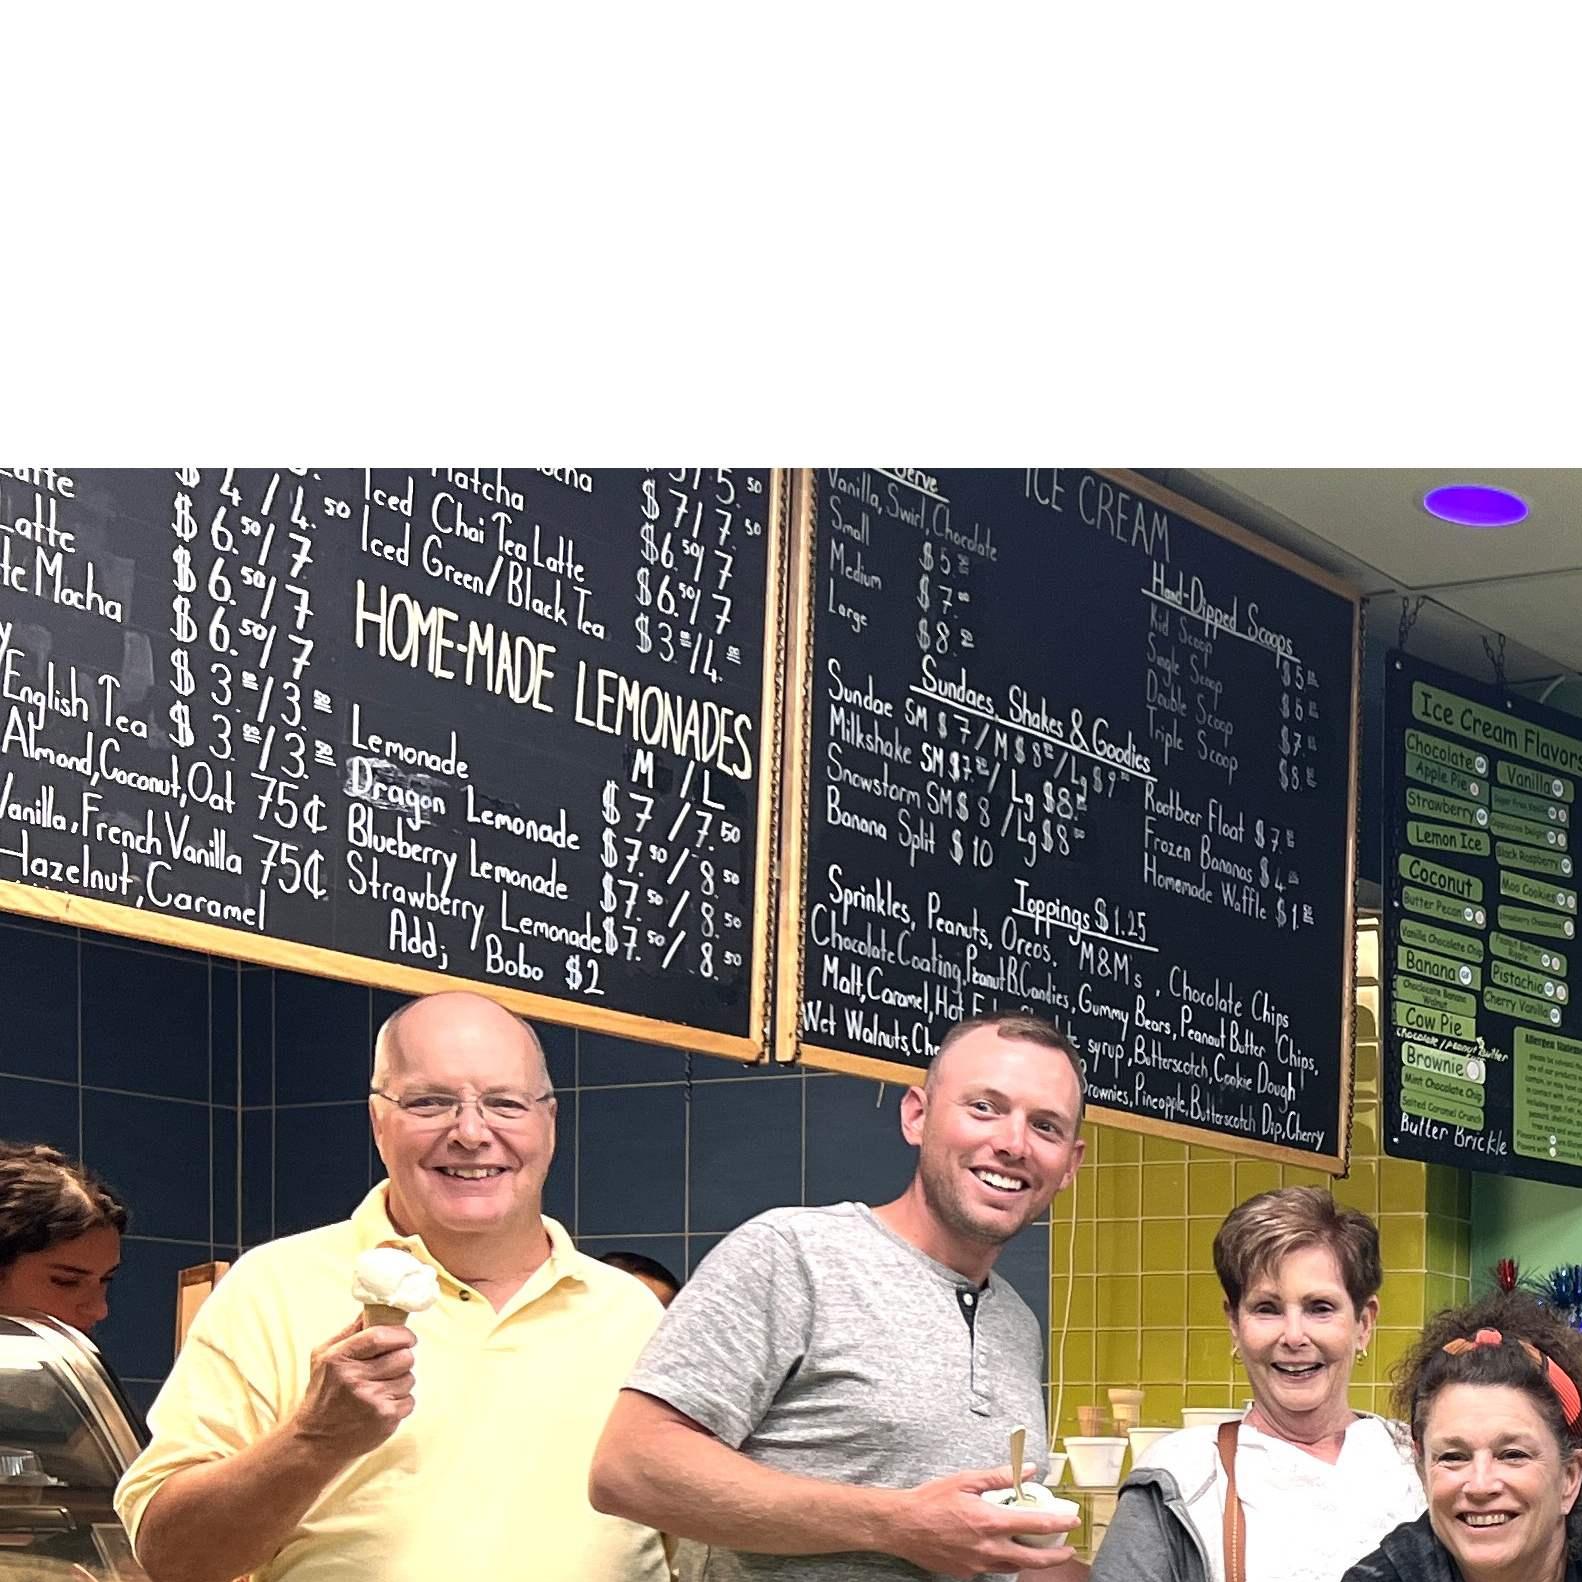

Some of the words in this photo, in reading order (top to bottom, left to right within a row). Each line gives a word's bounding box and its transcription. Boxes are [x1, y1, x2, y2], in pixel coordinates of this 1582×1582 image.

[0, 493, 76, 553] atte
[431, 491, 485, 544] Chai
[490, 511, 528, 562] Tea
[533, 523, 585, 583] Latte
[829, 494, 870, 547] Small
[932, 502, 998, 562] Chocolate
[1078, 475, 1170, 564] CREAM
[361, 503, 411, 567] Iced
[572, 585, 605, 641] Tea
[829, 538, 882, 591] Medium
[827, 577, 868, 633] Large
[1150, 600, 1170, 637] Kid
[1178, 615, 1213, 669] Scoop
[1151, 559, 1238, 640] Hand-Dipped
[1247, 601, 1294, 669] Scoops
[2, 647, 90, 731] English
[97, 674, 149, 739] Tea
[354, 579, 557, 713] HOME-MADE
[573, 659, 753, 781] LEMONADES
[827, 657, 894, 718] Sundae
[903, 697, 929, 733] SM
[1146, 668, 1188, 717] Double
[1195, 693, 1234, 749] Scoop
[1189, 653, 1224, 712] Scoop
[351, 702, 470, 780] Lemonade
[829, 702, 913, 765] Milkshake
[919, 742, 944, 778] SM
[1008, 684, 1065, 739] Shakes
[1068, 707, 1090, 752] &
[1091, 717, 1152, 774] Goodies
[1145, 704, 1185, 767] Triple
[1197, 728, 1239, 785] Scoop
[1405, 732, 1475, 771] Chocolate
[1420, 691, 1455, 726] Ice
[1459, 707, 1518, 750] Cream
[187, 761, 236, 814] Oat
[350, 755, 447, 832] Dragon
[465, 785, 581, 851] Lemonade
[631, 748, 654, 789] M
[702, 769, 726, 811] L
[827, 741, 921, 810] Snowstorm
[926, 780, 954, 819] SM
[1407, 791, 1475, 824] Strawberry
[1415, 760, 1449, 784] Apple
[1450, 771, 1468, 791] Pie
[1507, 764, 1551, 795] Vanilla
[82, 791, 163, 856] French
[164, 810, 243, 875] Vanilla
[826, 784, 888, 841] Banana
[897, 807, 936, 868] Split
[1144, 780, 1203, 828] Rootbeer
[1207, 797, 1245, 844] Float
[1415, 825, 1457, 849] Lemon
[1459, 832, 1483, 852] Ice
[347, 802, 458, 900] Blueberry
[469, 838, 569, 901] Lemonade
[1143, 815, 1191, 863] Frozen
[1200, 833, 1254, 885] Bananas
[1408, 859, 1473, 898] Coconut
[146, 860, 266, 931] Caramel
[346, 850, 485, 951] Strawberry
[501, 890, 604, 954] Lemonade
[1013, 877, 1091, 946] Toppings
[1143, 851, 1214, 904] Homemade
[1221, 880, 1268, 920] Waffle
[1403, 890, 1434, 910] Butter
[484, 933, 544, 982] Bobo
[810, 902, 896, 965] Chocolate
[1077, 983, 1130, 1042] Gummy
[1229, 1019, 1267, 1059] Butter
[1406, 949, 1456, 981] Banana
[1492, 964, 1545, 994] Pistachio
[1168, 965, 1242, 1018] Chocolate
[1251, 989, 1289, 1044] Chips
[1405, 1007, 1436, 1031] Cow
[1440, 1013, 1463, 1037] Pie
[1483, 989, 1517, 1012] Cherry
[802, 999, 838, 1037] Wet
[1189, 1083, 1257, 1133] Butterscotch
[1285, 1110, 1326, 1152] Cherry
[934, 983, 966, 1022] Hot
[1213, 1052, 1254, 1092] Cookie
[1257, 1060, 1297, 1114] Dough
[1406, 1045, 1465, 1077] Brownie
[1404, 1073, 1423, 1086] Mint
[1424, 1077, 1464, 1097] Chocolate
[1400, 1111, 1449, 1140] Butter
[1453, 1125, 1509, 1156] Brickle
